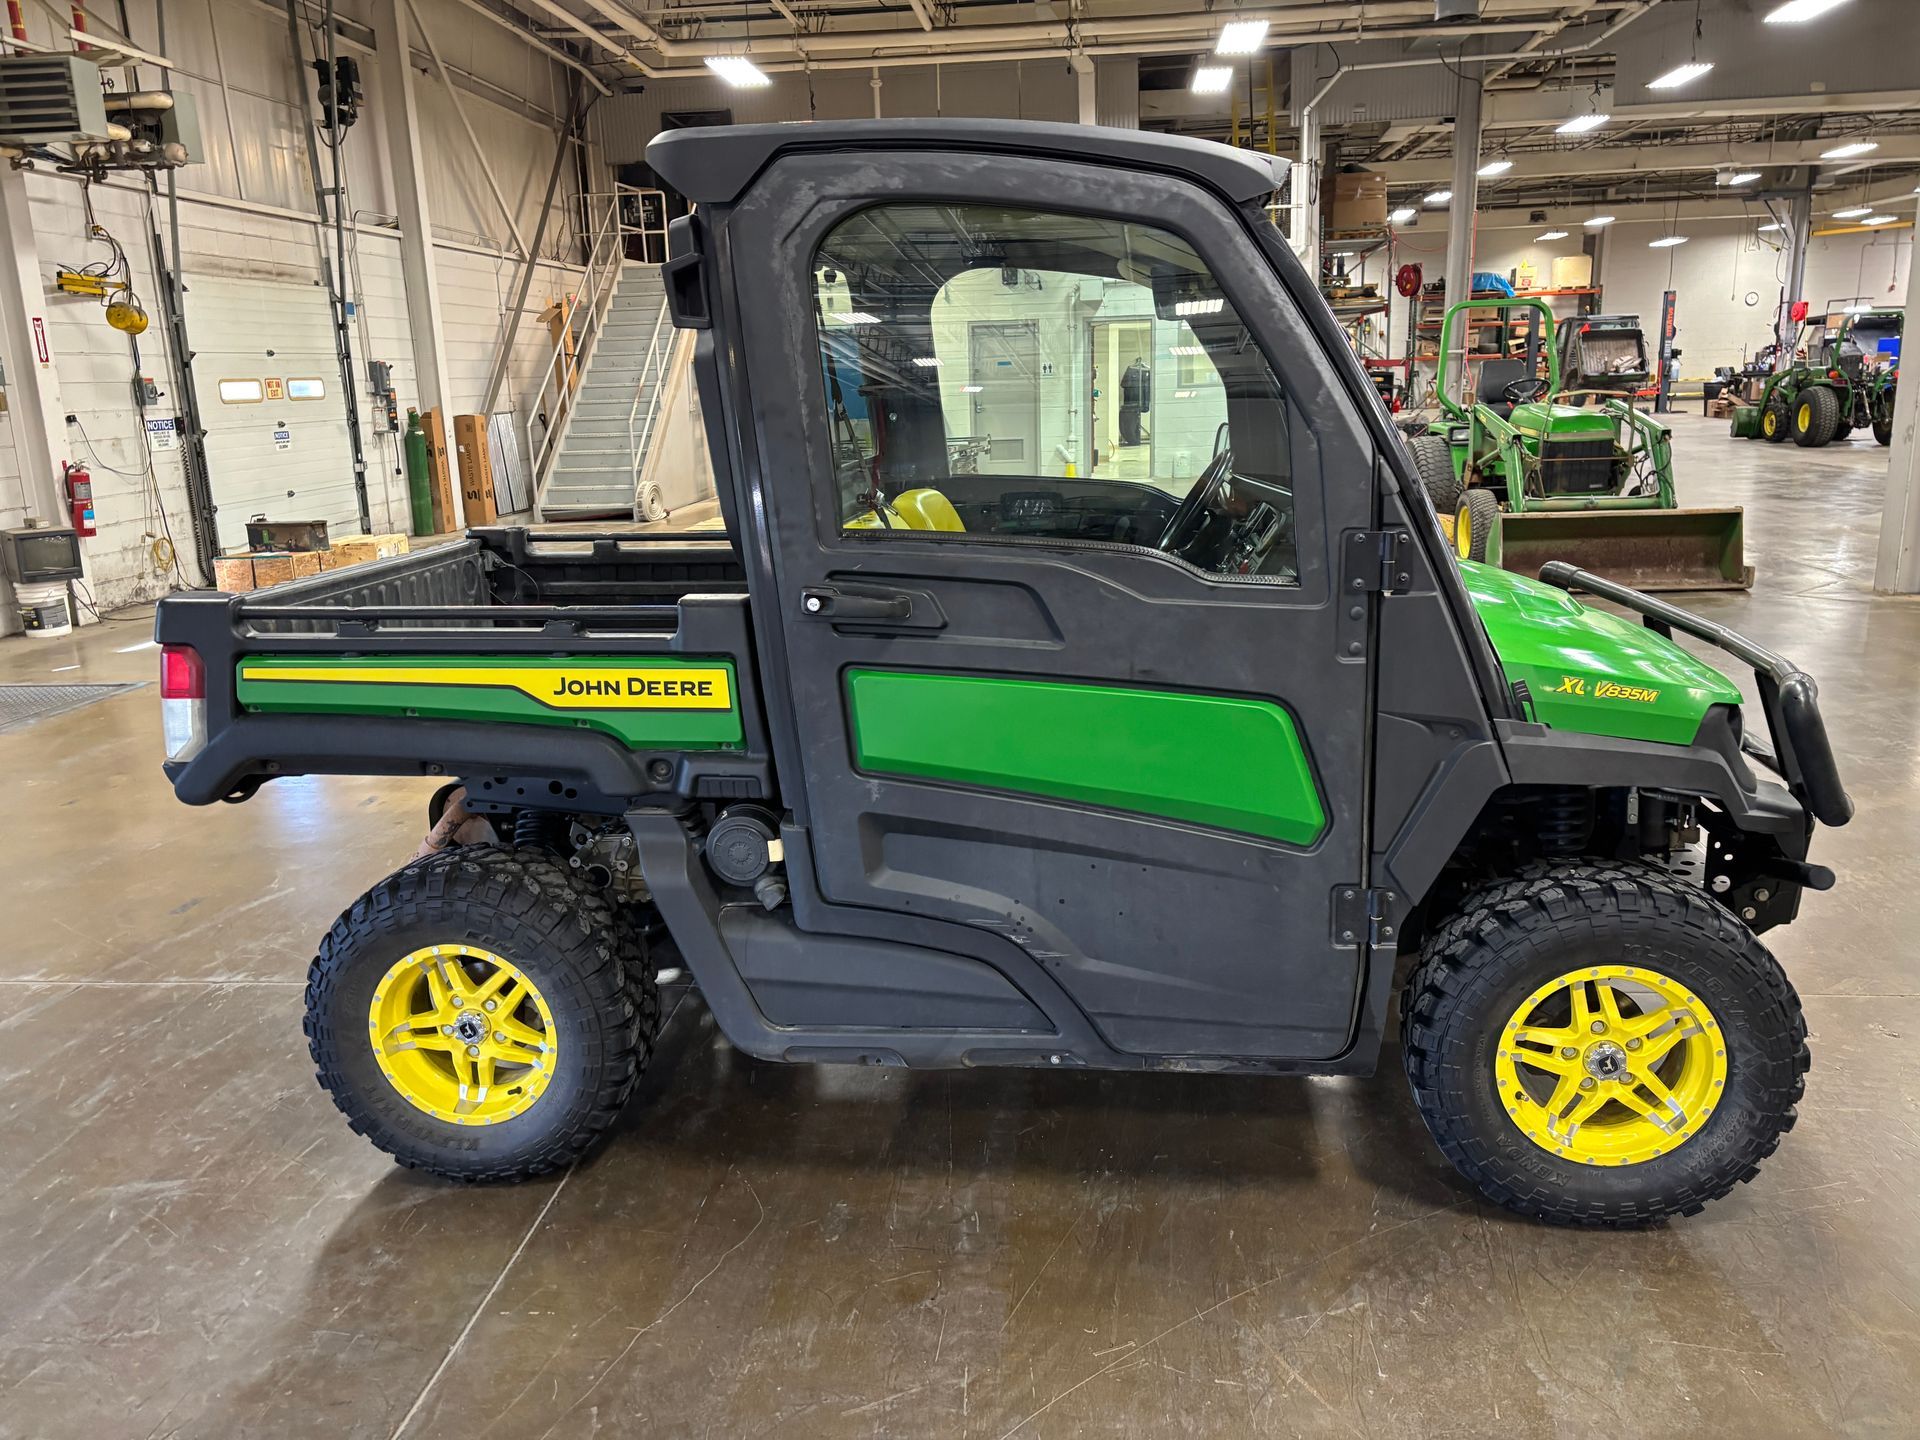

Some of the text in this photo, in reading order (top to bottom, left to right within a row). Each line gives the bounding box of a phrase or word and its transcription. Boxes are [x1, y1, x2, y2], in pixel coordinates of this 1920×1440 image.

[270, 389, 279, 397] EXIT
[147, 420, 173, 431] NOTICE
[275, 432, 289, 440] NOTICE
[464, 443, 473, 465] LAMPS
[466, 465, 475, 487] WASTE
[553, 677, 713, 697] JOHN DEERE
[1556, 677, 1659, 702] XL V835M
[1496, 1132, 1571, 1187] KENDA
